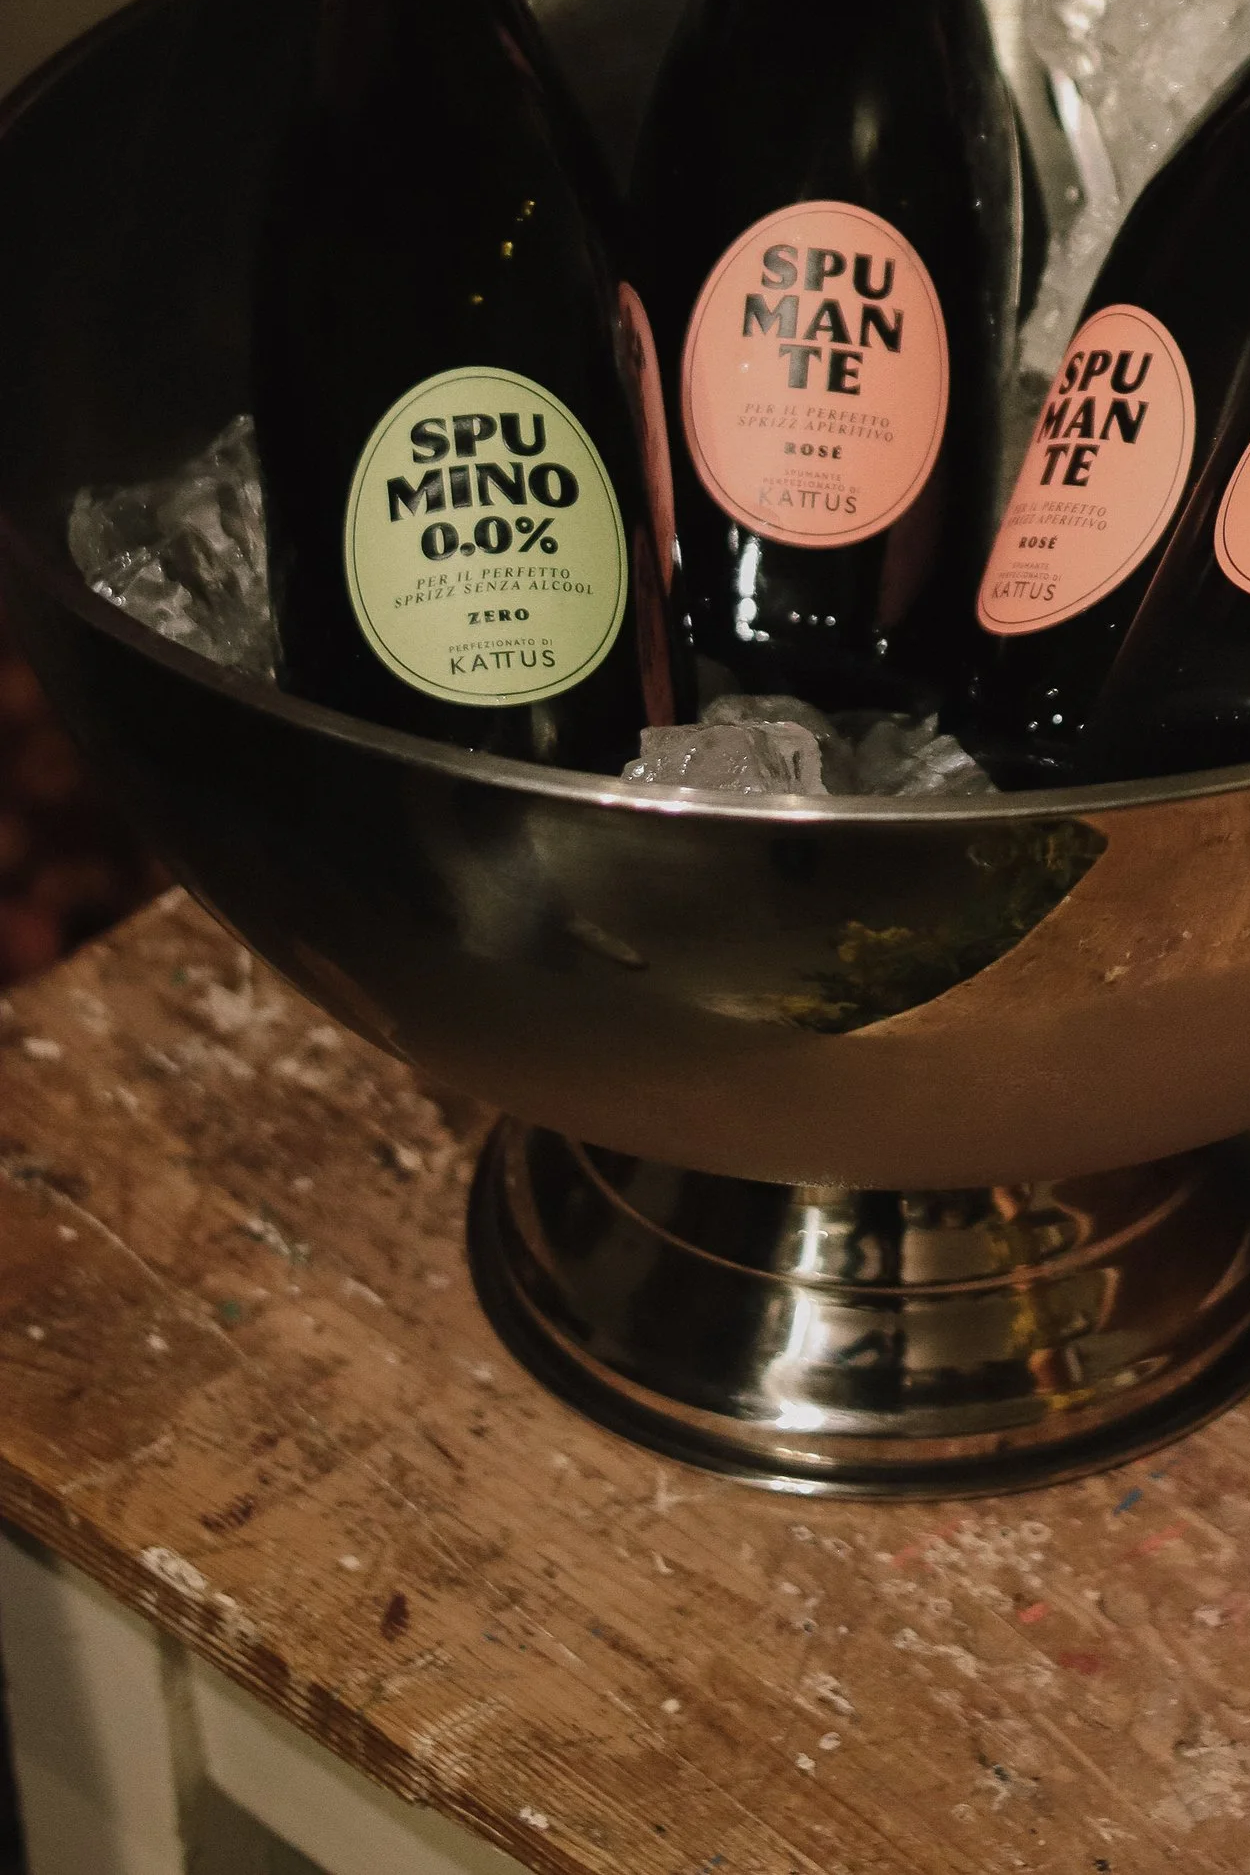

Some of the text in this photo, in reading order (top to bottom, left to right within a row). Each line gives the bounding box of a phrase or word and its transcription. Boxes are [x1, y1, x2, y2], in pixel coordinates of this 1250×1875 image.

[761, 243, 896, 301] SPU
[742, 292, 905, 353] MAN
[778, 343, 864, 395] TE
[1058, 349, 1154, 395] SPU
[737, 416, 894, 443] SPRIZZ APERITIVO
[744, 403, 890, 428] PER IL PERFETTO
[1037, 395, 1150, 444] MAN
[410, 412, 546, 463] SPU
[784, 441, 842, 460] ROSÉ
[1039, 443, 1101, 487] TE
[386, 462, 579, 523] MINO
[759, 486, 857, 514] KATTUS
[421, 515, 559, 561] 0.0%
[1018, 535, 1058, 549] ROSÉ
[417, 566, 571, 590] PER IL PERFETTO
[991, 581, 1057, 601] KATTUS
[394, 580, 595, 609] SPRIZZ SENZA ALCOOL
[468, 608, 530, 625] ZERO
[449, 638, 553, 653] PERFEZIONATO DI
[450, 649, 556, 675] KATTUS
